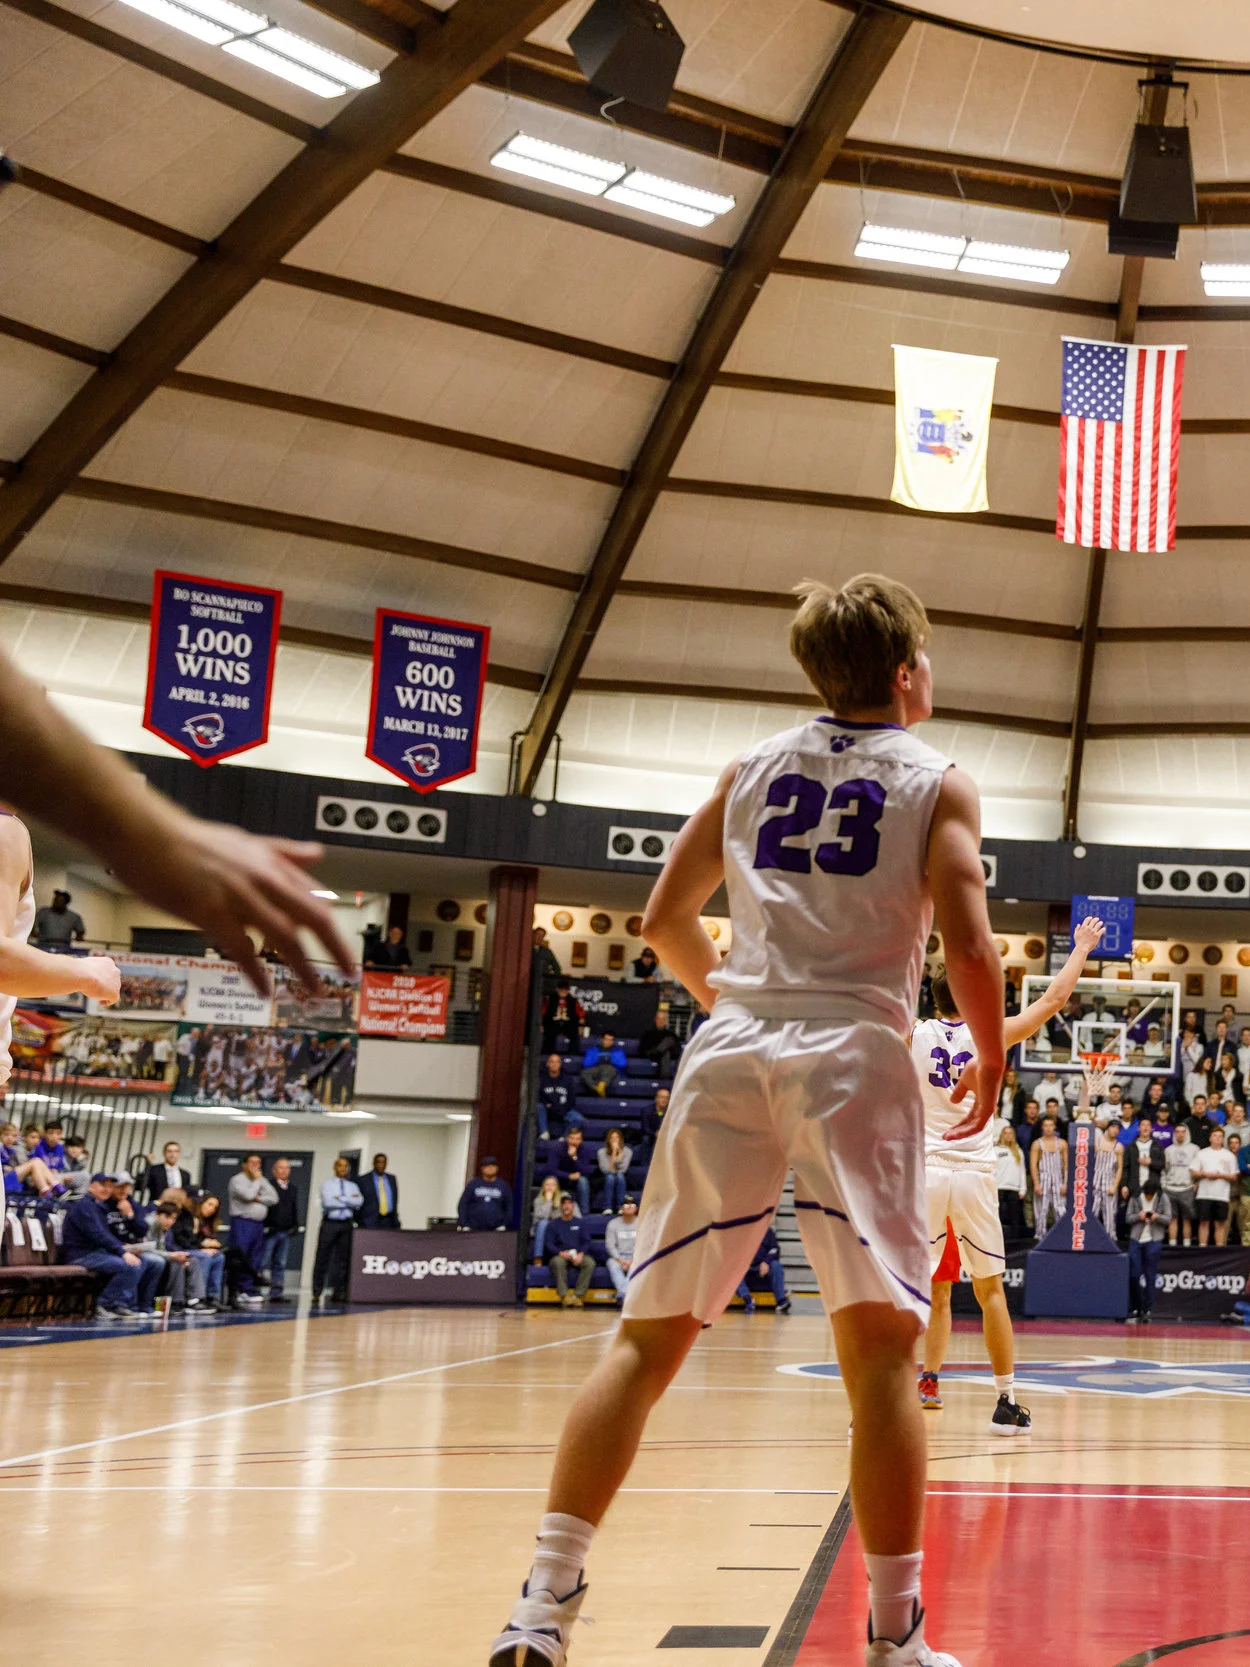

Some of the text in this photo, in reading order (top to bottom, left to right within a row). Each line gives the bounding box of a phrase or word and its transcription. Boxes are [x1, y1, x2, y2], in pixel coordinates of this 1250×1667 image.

[190, 604, 245, 624] SOFTBALL
[177, 624, 253, 658] 1,000
[389, 624, 476, 648] JOHNNY JOHNSON
[408, 640, 456, 659] BASEBALL
[174, 652, 251, 685] WINS
[405, 660, 455, 690] 600
[168, 686, 207, 704] APRIL
[208, 691, 220, 707] 2,
[394, 685, 463, 717] WINS
[383, 716, 425, 735] MARCH
[443, 725, 469, 741] 2017
[753, 773, 887, 876] 23
[360, 1015, 398, 1033] National
[1071, 1127, 1090, 1251] BROOKDALE
[362, 1255, 506, 1279] HoopGroup
